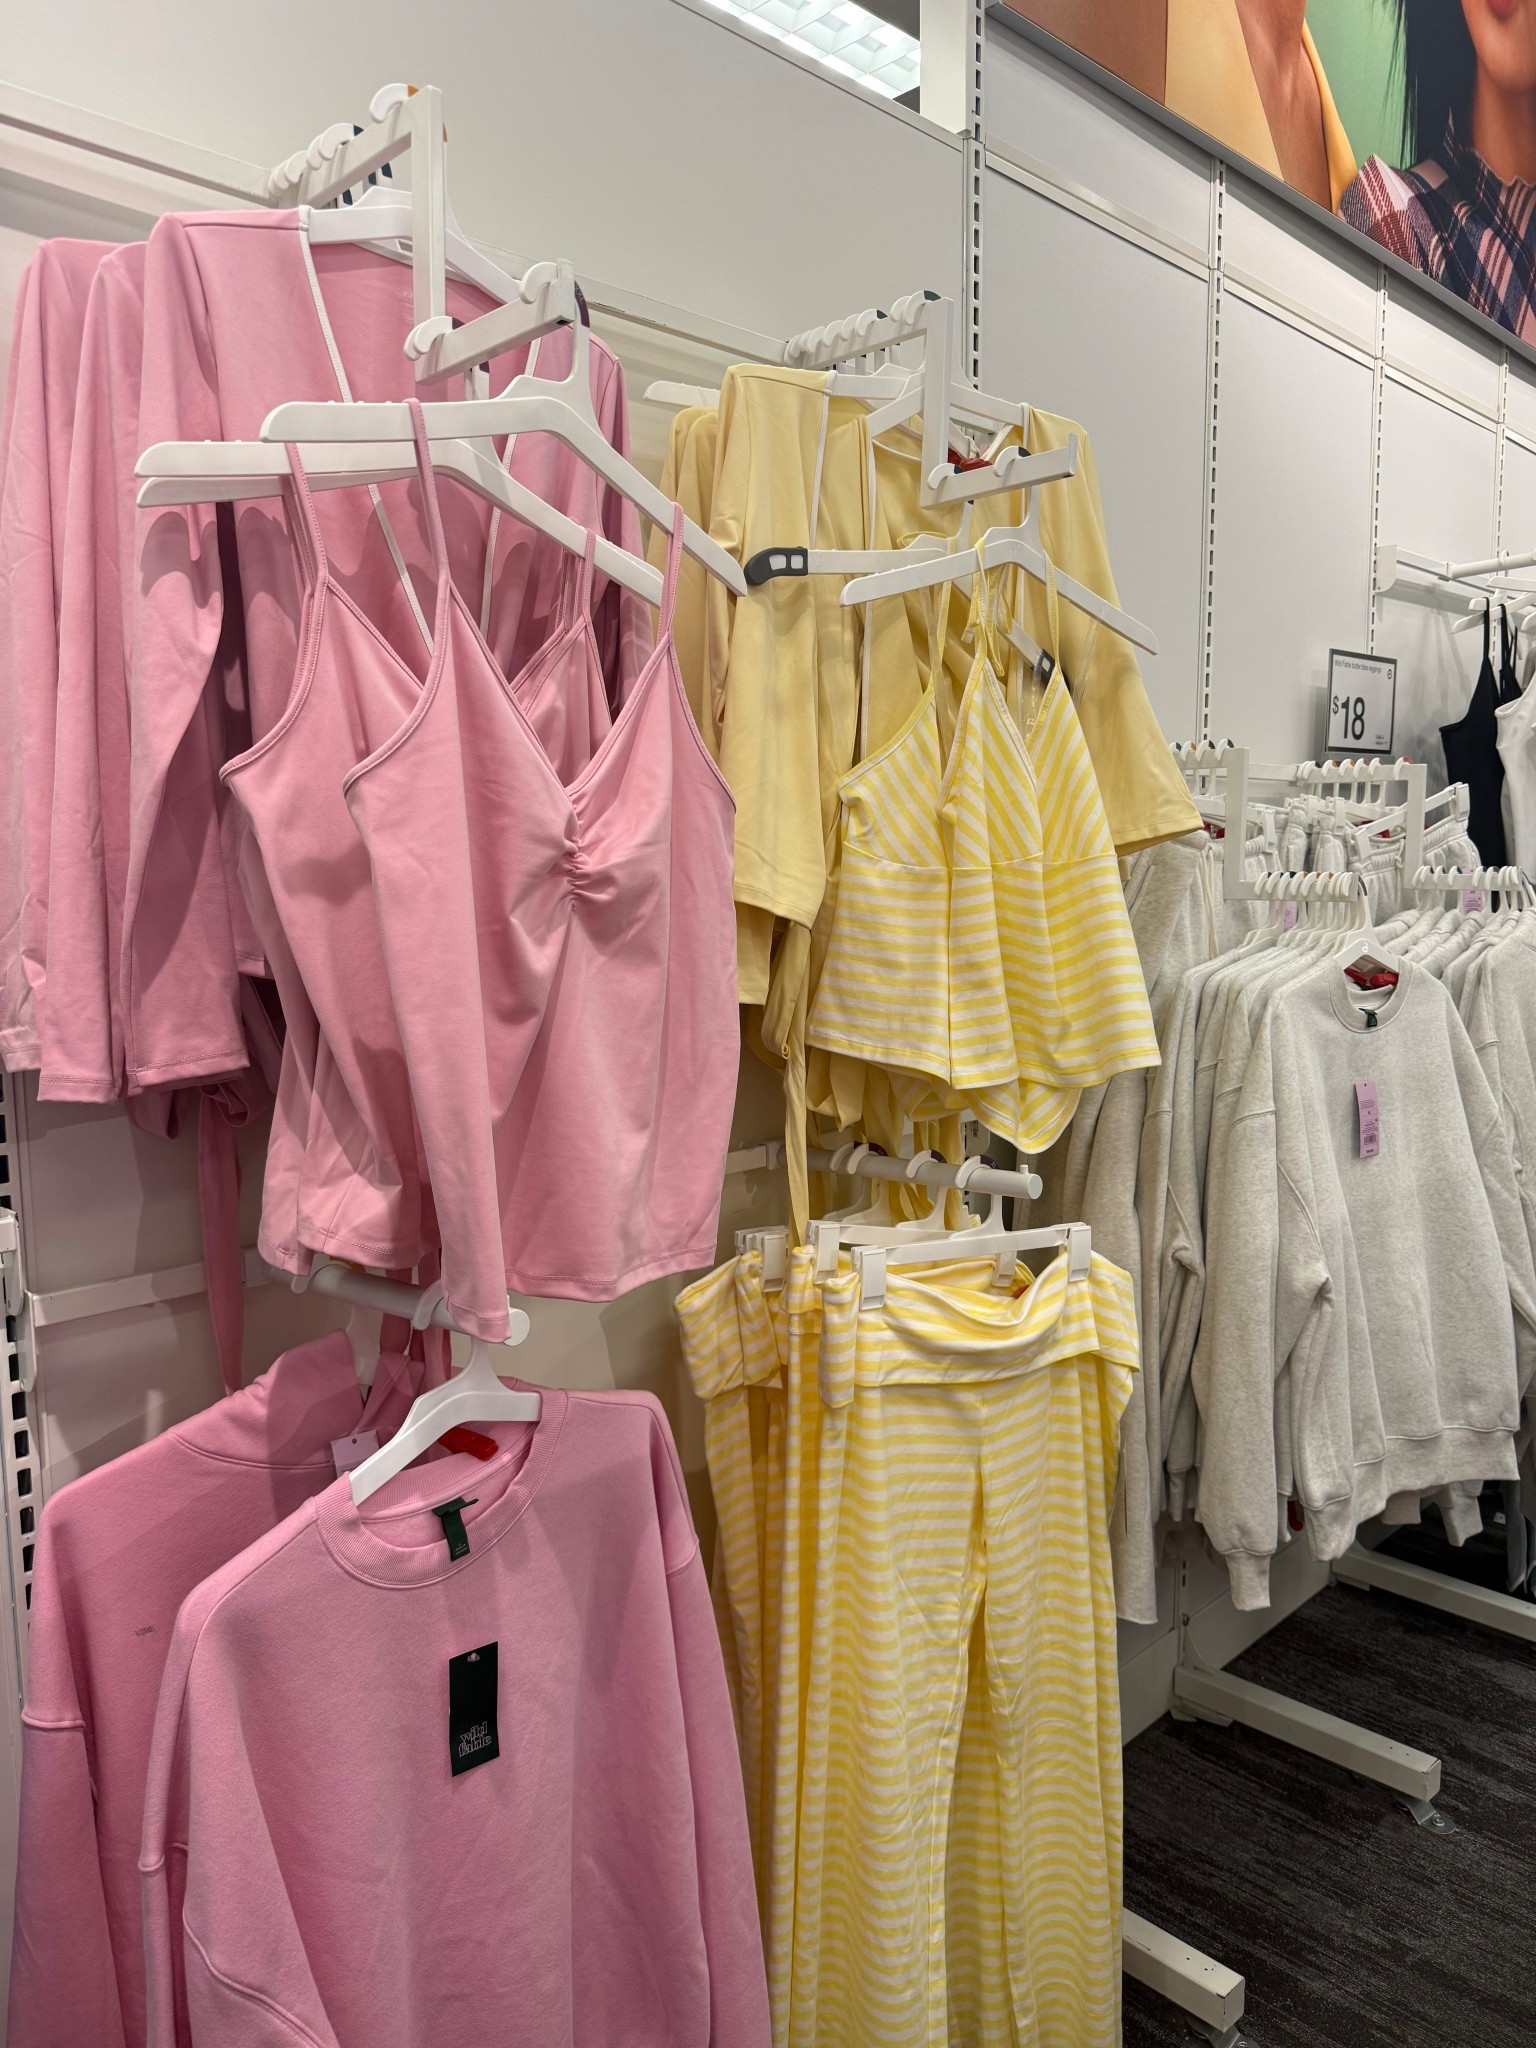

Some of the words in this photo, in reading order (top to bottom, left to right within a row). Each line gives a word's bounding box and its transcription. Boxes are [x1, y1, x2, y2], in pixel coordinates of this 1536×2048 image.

[1332, 694, 1366, 741] $18
[460, 1720, 488, 1742] wild
[458, 1734, 492, 1758] fable
